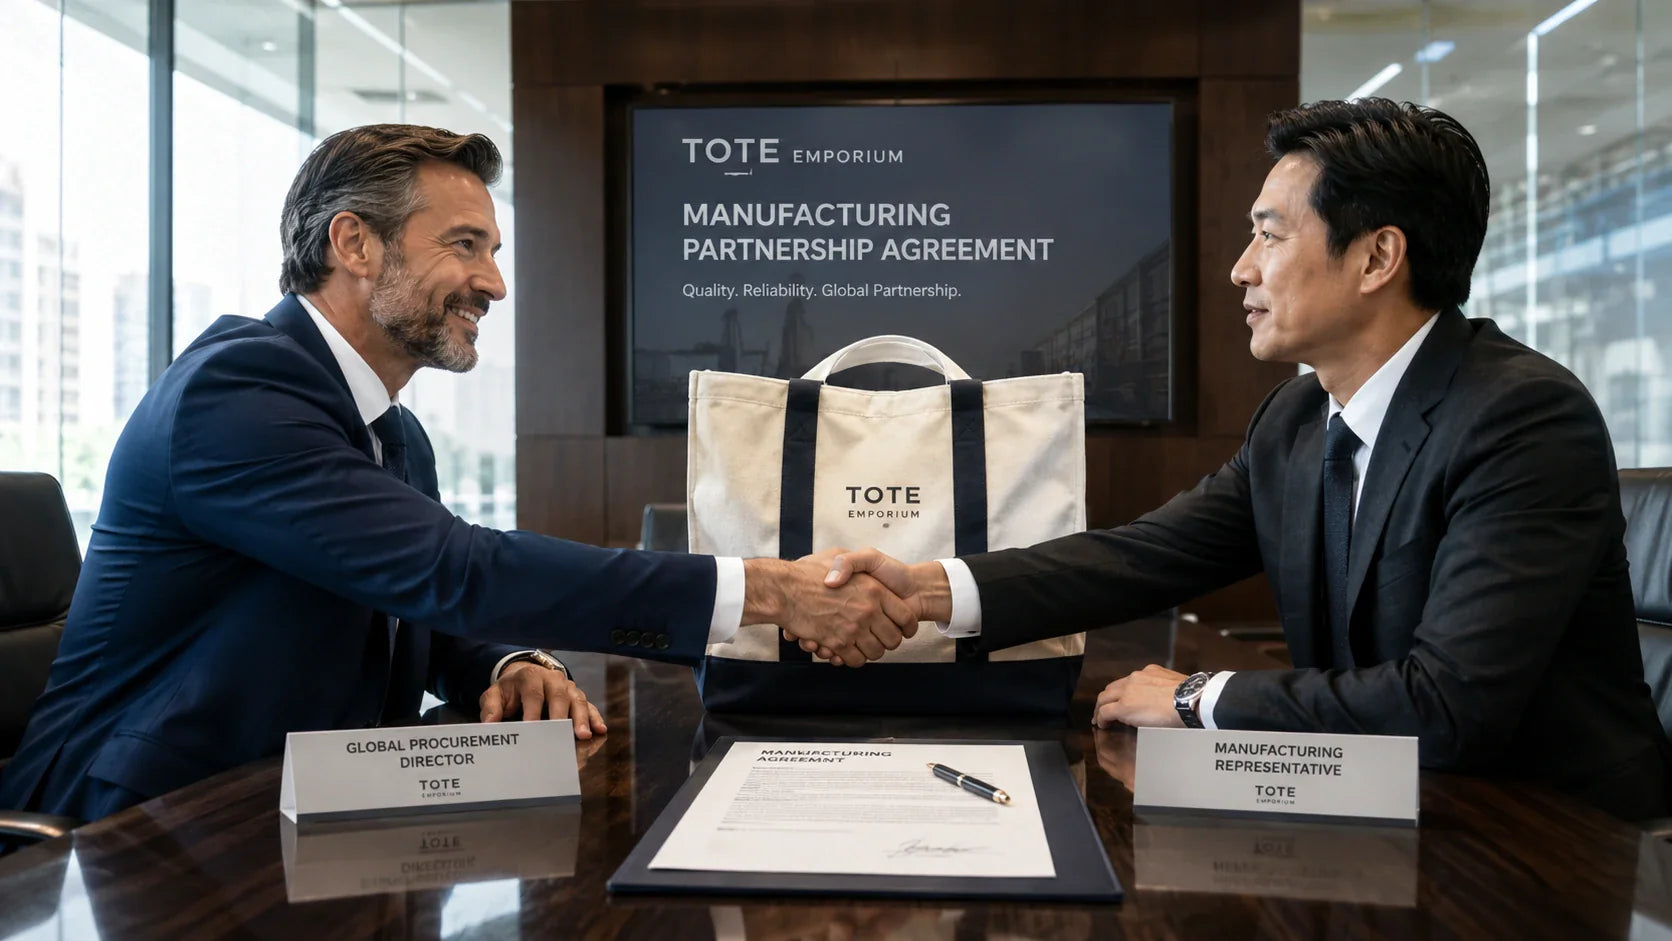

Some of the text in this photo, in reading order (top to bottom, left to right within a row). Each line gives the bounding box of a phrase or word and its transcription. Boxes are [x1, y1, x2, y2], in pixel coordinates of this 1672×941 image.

[682, 138, 904, 164] TOTE EMPORIUM
[683, 202, 951, 227] MANUFACTURING
[683, 238, 1054, 261] PARTNERSHIP AGREEMENT
[682, 283, 962, 300] Quality. Reliability. Global Partnership.
[846, 486, 921, 504] TOTE
[848, 510, 920, 519] EMPORIUM
[346, 733, 520, 754] GLOBAL PROCUREMENT
[1214, 742, 1344, 760] MANUFACTURING
[400, 753, 475, 769] DIRECTOR
[1215, 760, 1342, 777] REPRESENTATIVE
[419, 778, 461, 790] TOTE
[1255, 785, 1296, 797] TOTE
